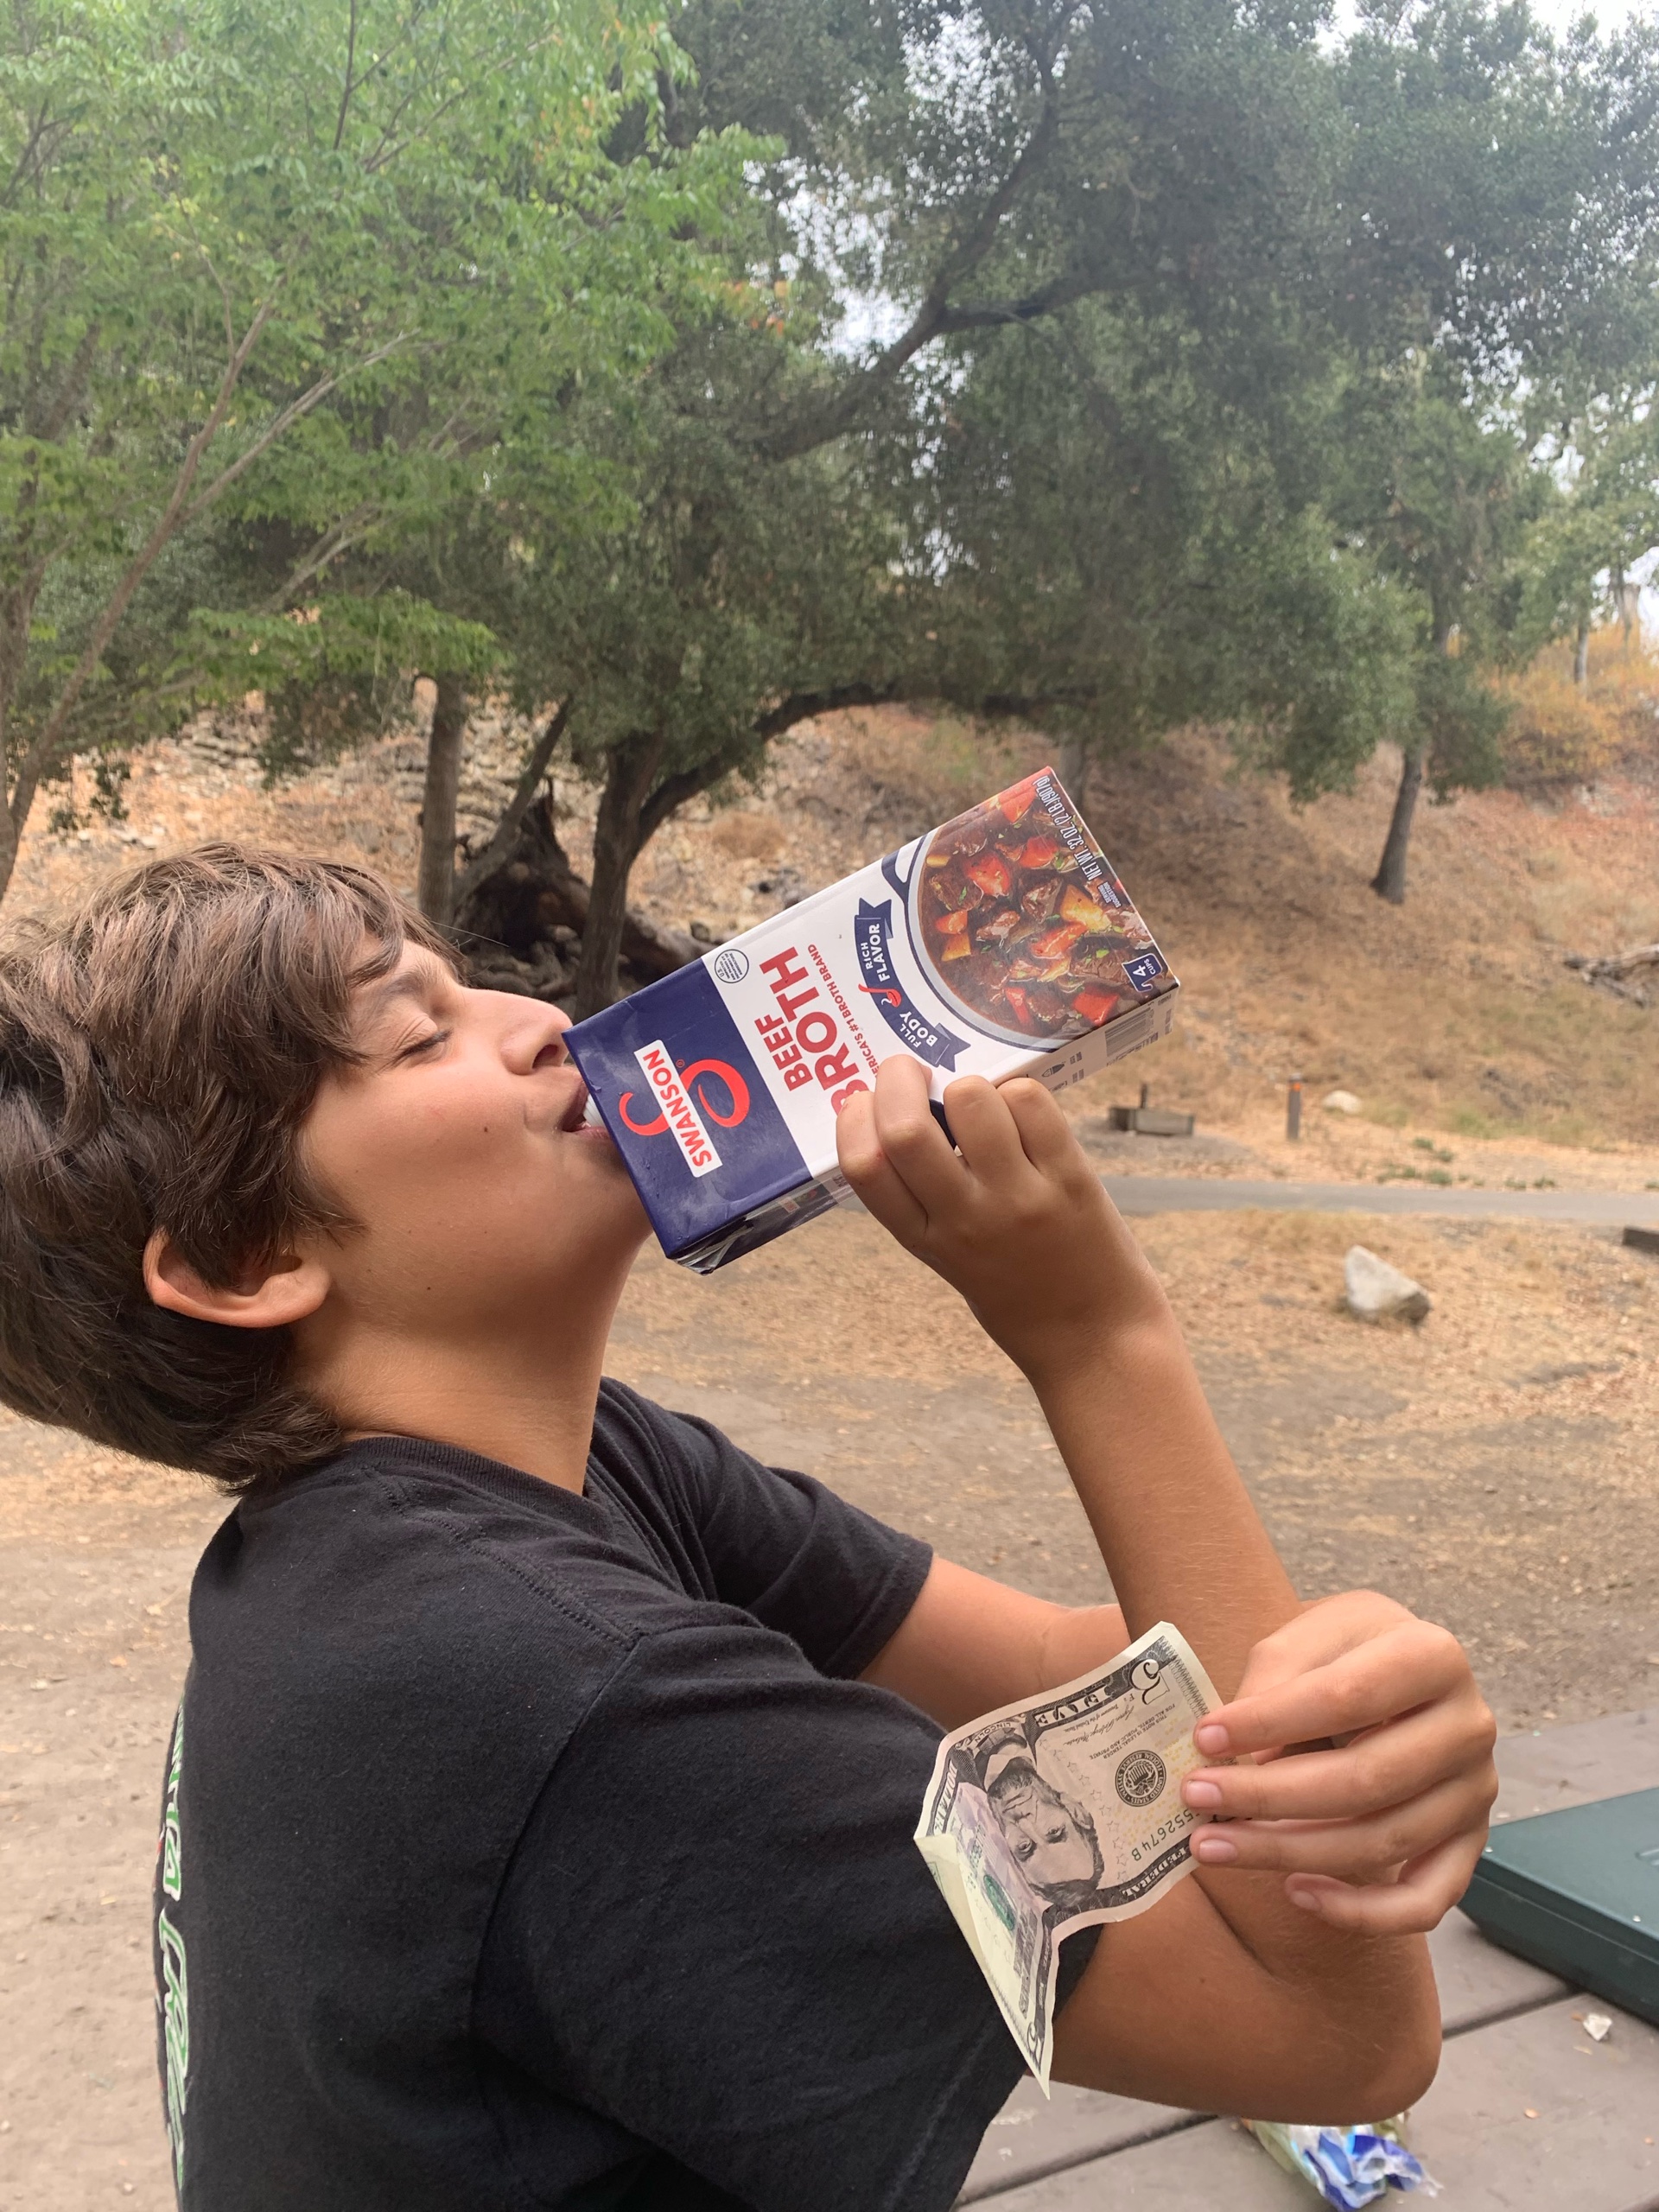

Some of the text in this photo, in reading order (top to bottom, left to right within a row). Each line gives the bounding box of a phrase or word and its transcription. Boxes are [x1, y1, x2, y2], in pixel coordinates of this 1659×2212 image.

[1060, 821, 1078, 839] OZ.
[1067, 836, 1084, 850] 32
[1073, 845, 1094, 866] WT.
[1082, 861, 1103, 880] NET
[861, 942, 873, 969] RICH
[868, 923, 891, 982] FLAVOR
[1143, 958, 1156, 976] CUPS
[1133, 964, 1147, 977] 4
[807, 944, 879, 1077] ERICA'S #1 BROTH BRAND
[899, 1011, 938, 1047] BODY
[899, 1023, 921, 1048] FULL
[754, 1014, 813, 1091] BEEF
[643, 1049, 712, 1166] SWANSON
[1128, 1658, 1170, 1705] 5
[1034, 1684, 1109, 1728] FIVE
[975, 1721, 1011, 1745] LINCOLN
[1141, 1808, 1200, 1851] 552674
[1122, 1847, 1187, 1897] FEDERAL
